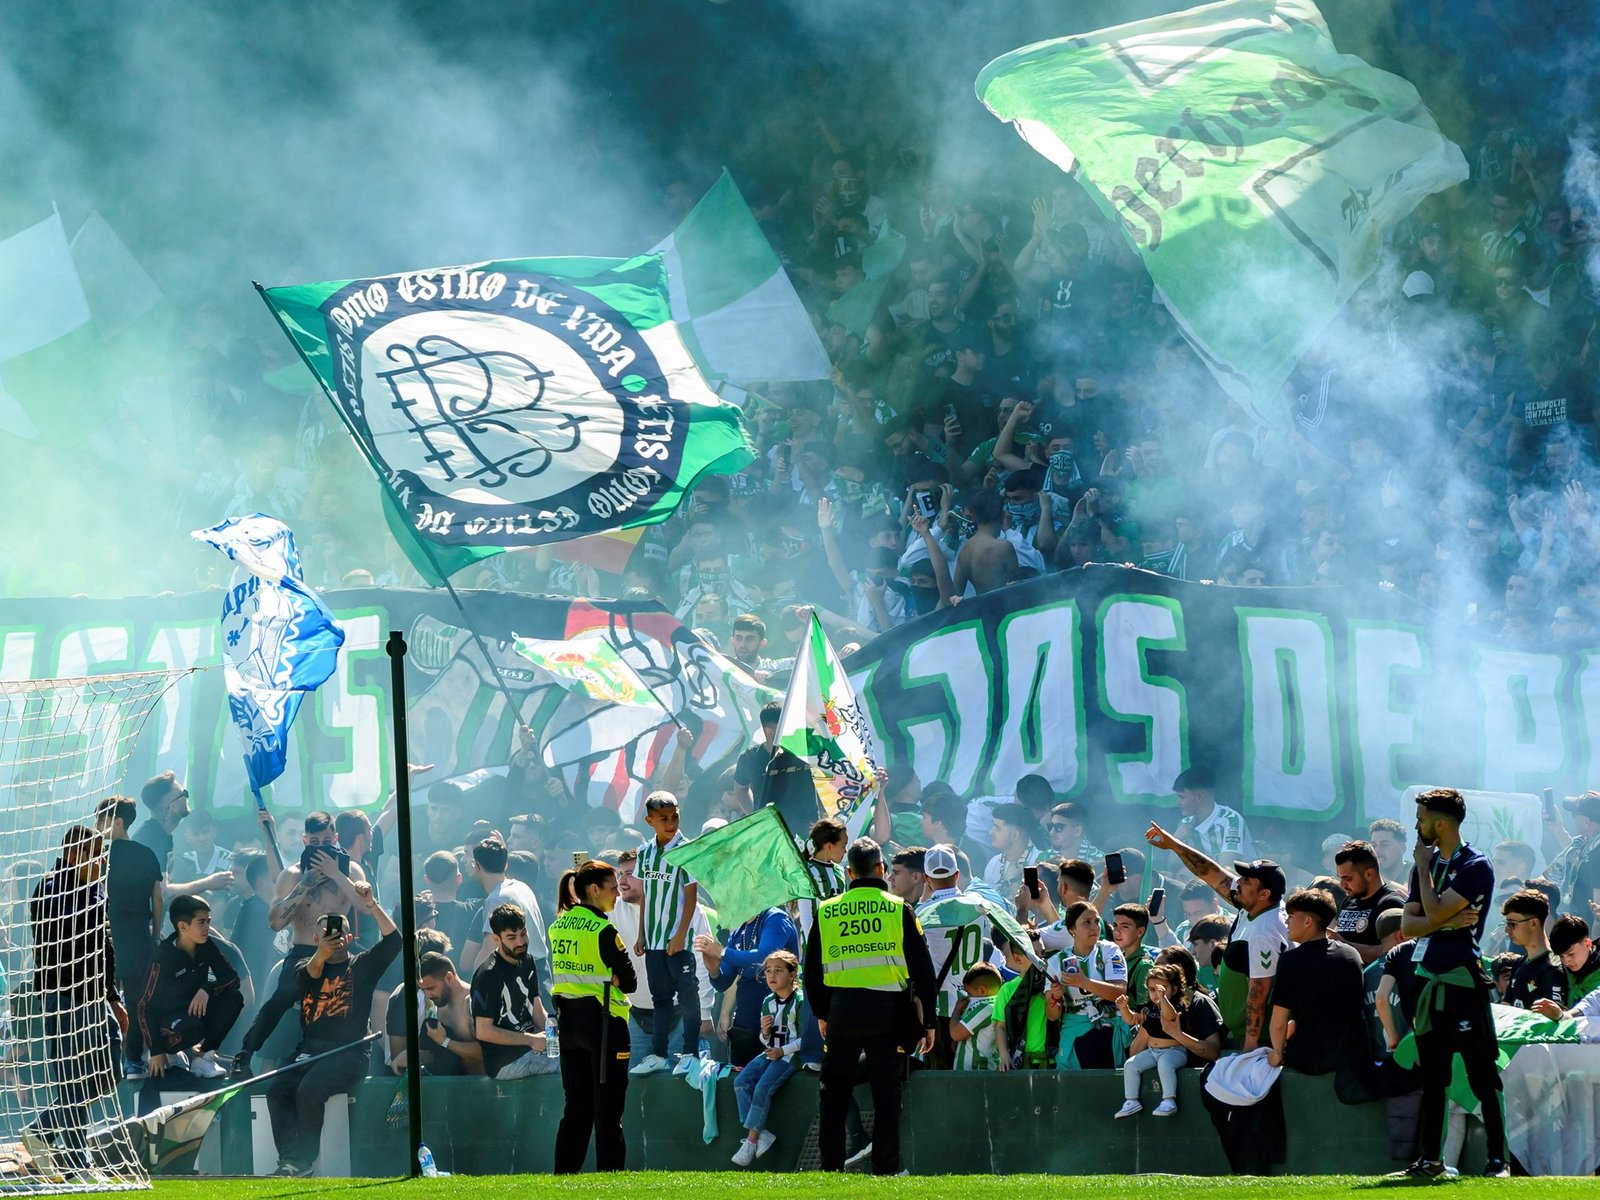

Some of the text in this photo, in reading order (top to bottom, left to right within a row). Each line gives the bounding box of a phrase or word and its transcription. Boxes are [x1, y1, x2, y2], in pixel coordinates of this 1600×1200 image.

[511, 279, 567, 315] DE
[560, 305, 636, 377] VIDA
[1234, 606, 1434, 828] DE
[824, 901, 897, 919] SEGURIDAD
[839, 918, 882, 937] 2500
[552, 939, 579, 955] 2571
[841, 942, 897, 955] PROSEGUR
[944, 925, 982, 976] 10
